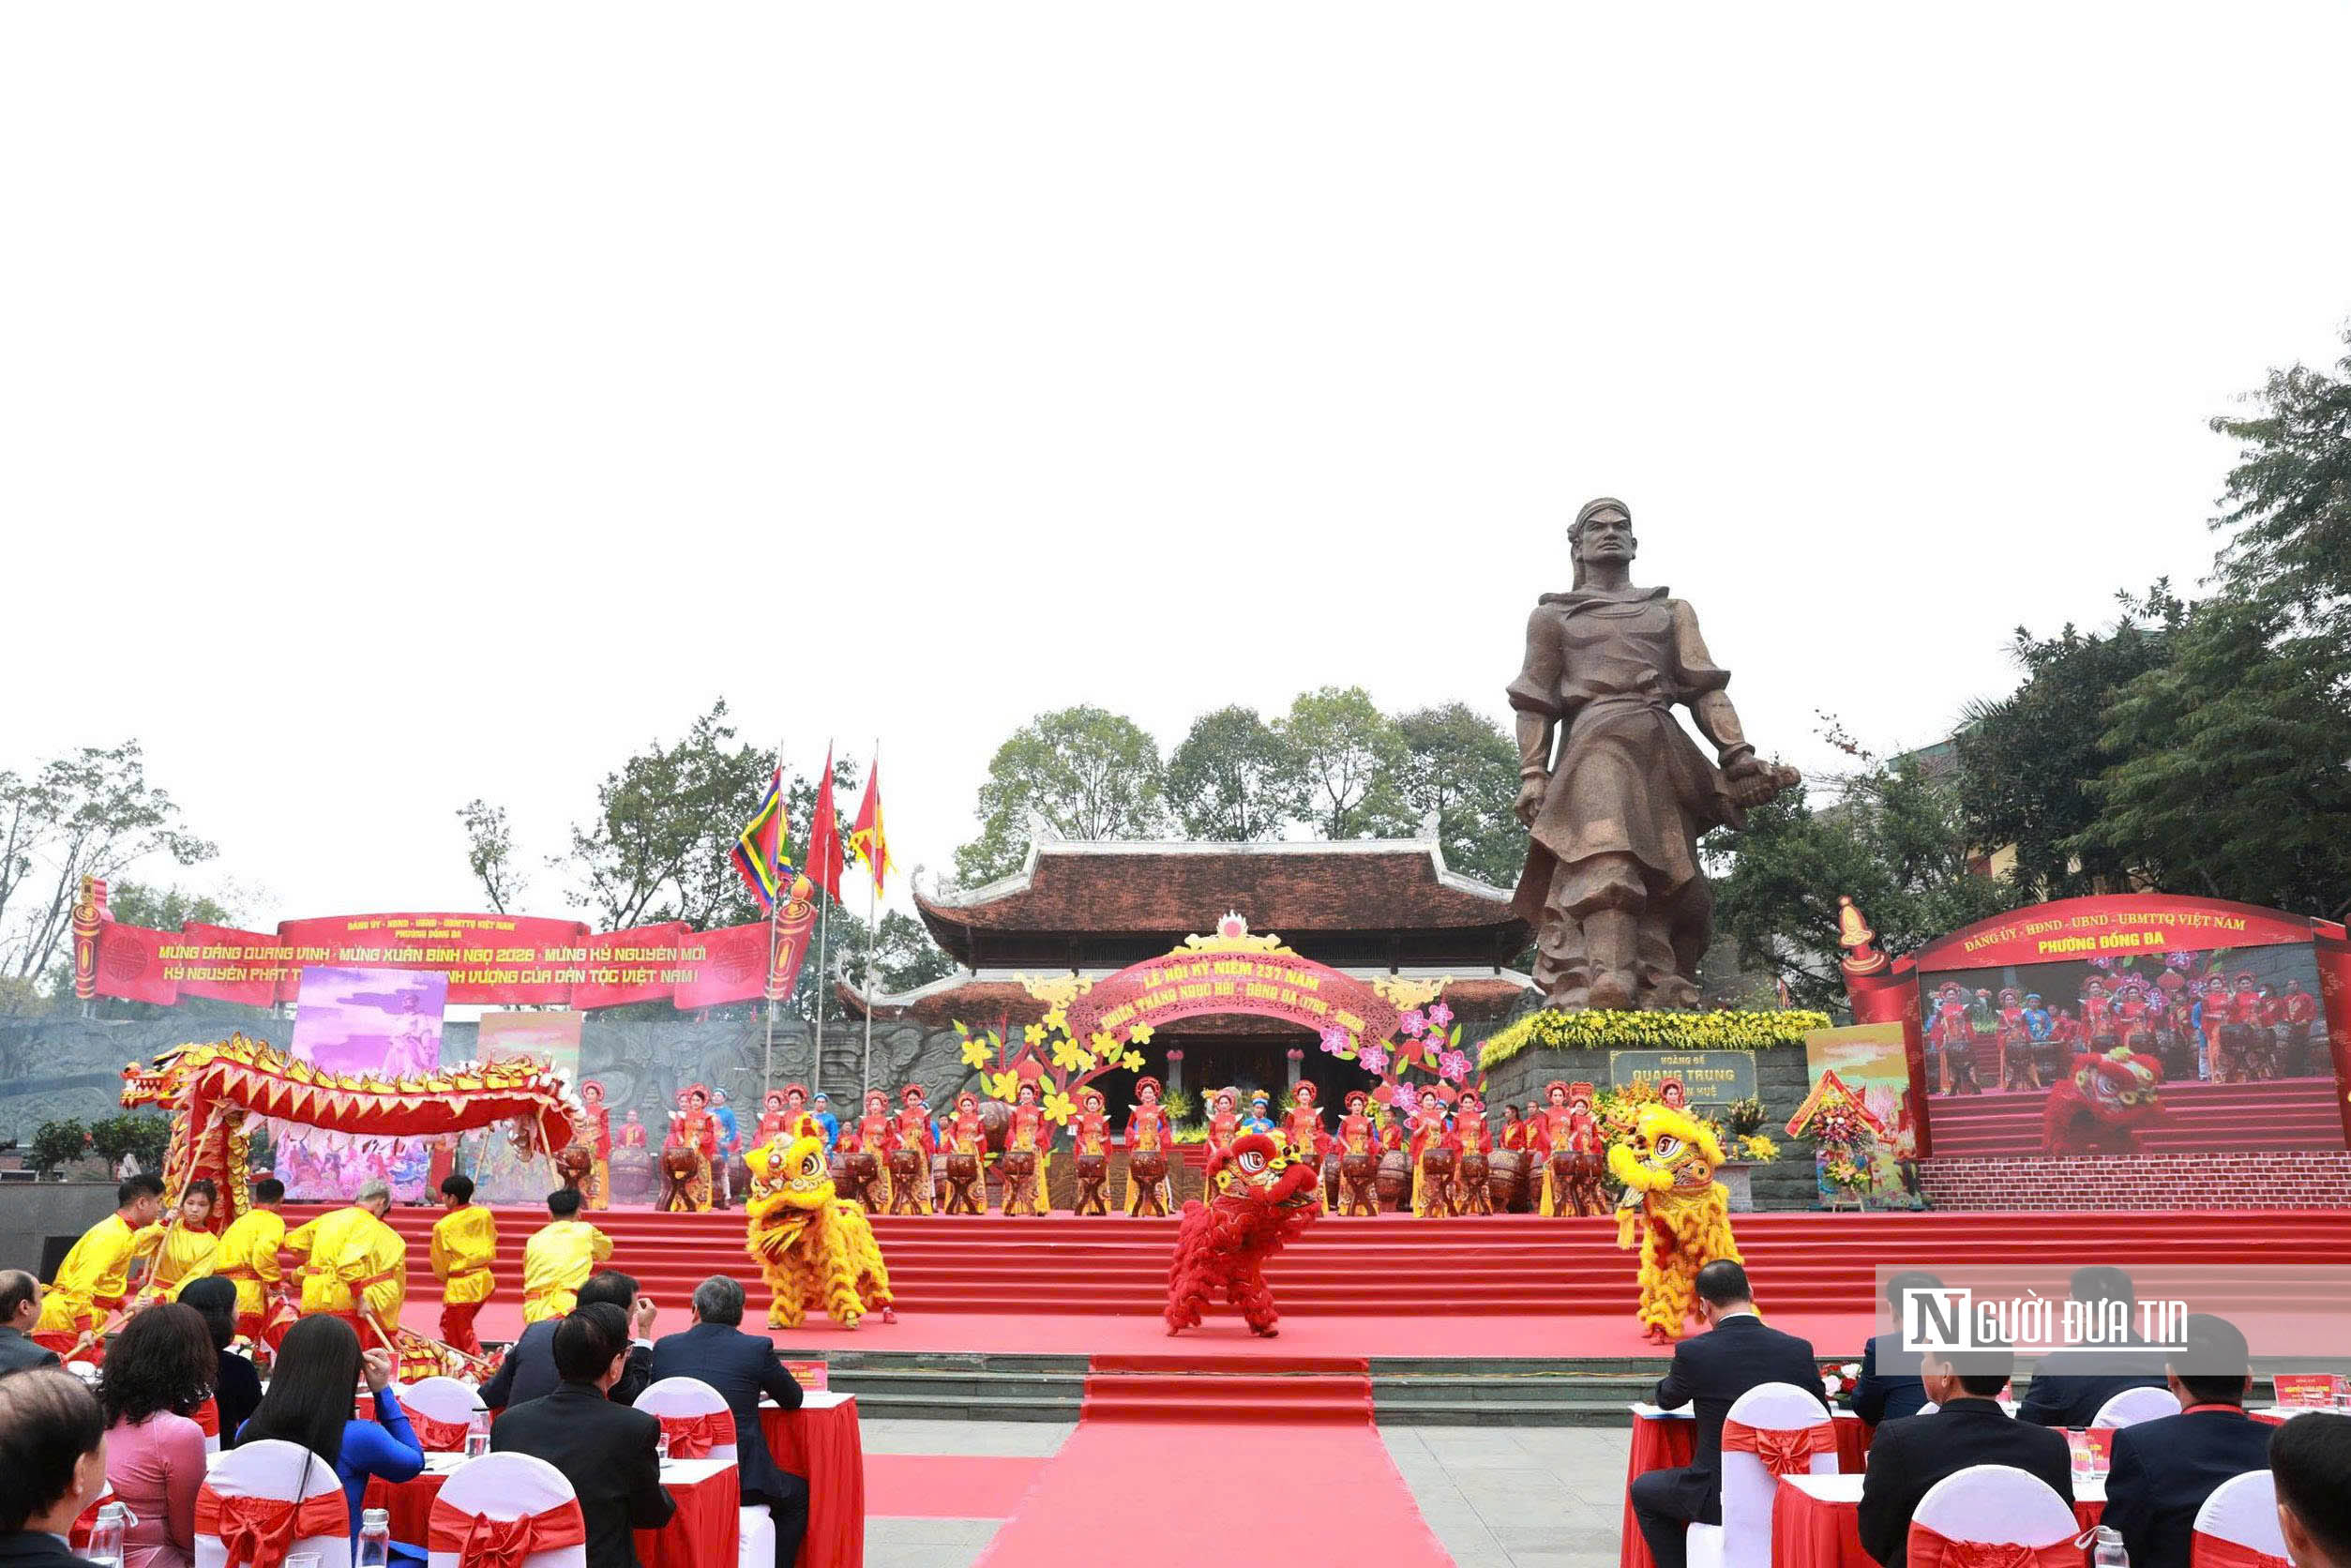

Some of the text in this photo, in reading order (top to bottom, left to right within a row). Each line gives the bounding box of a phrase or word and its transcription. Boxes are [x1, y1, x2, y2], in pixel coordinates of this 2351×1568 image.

[1964, 935, 1998, 952] ĐẢNG
[2000, 926, 2016, 941] ỦY
[2026, 919, 2063, 935] HĐND
[2071, 914, 2109, 927] UBND
[2117, 912, 2176, 927] UBMTTQ
[2178, 912, 2211, 929] VIỆT
[2213, 916, 2246, 931] NAM
[2038, 930, 2164, 954] PHƯỜNG ĐỐNG ĐA
[159, 942, 199, 959] MỪNG
[202, 942, 241, 959] ĐẢNG
[244, 947, 294, 960] QUANG
[296, 947, 330, 960] VINH
[339, 943, 381, 961] MỪNG
[383, 945, 423, 962] XUÂN
[426, 945, 460, 962] BÍNH
[463, 948, 493, 966] NGỌ
[495, 948, 535, 962] 2026
[545, 943, 587, 961] MỪNG
[590, 943, 611, 961] KỶ
[614, 944, 677, 961] NGUYÊN
[681, 943, 706, 961] MỚI
[163, 962, 184, 980] KỶ
[188, 964, 247, 981] NGUYÊN
[468, 968, 519, 987] VƯỢNG
[521, 966, 551, 984] CỦA
[554, 966, 585, 983] DÂN
[590, 966, 619, 986] TỘC
[623, 966, 656, 986] VIỆT
[660, 970, 698, 984] NAM!
[1258, 964, 1282, 980] 237
[1632, 1069, 1736, 1081] QUANG TRUNG
